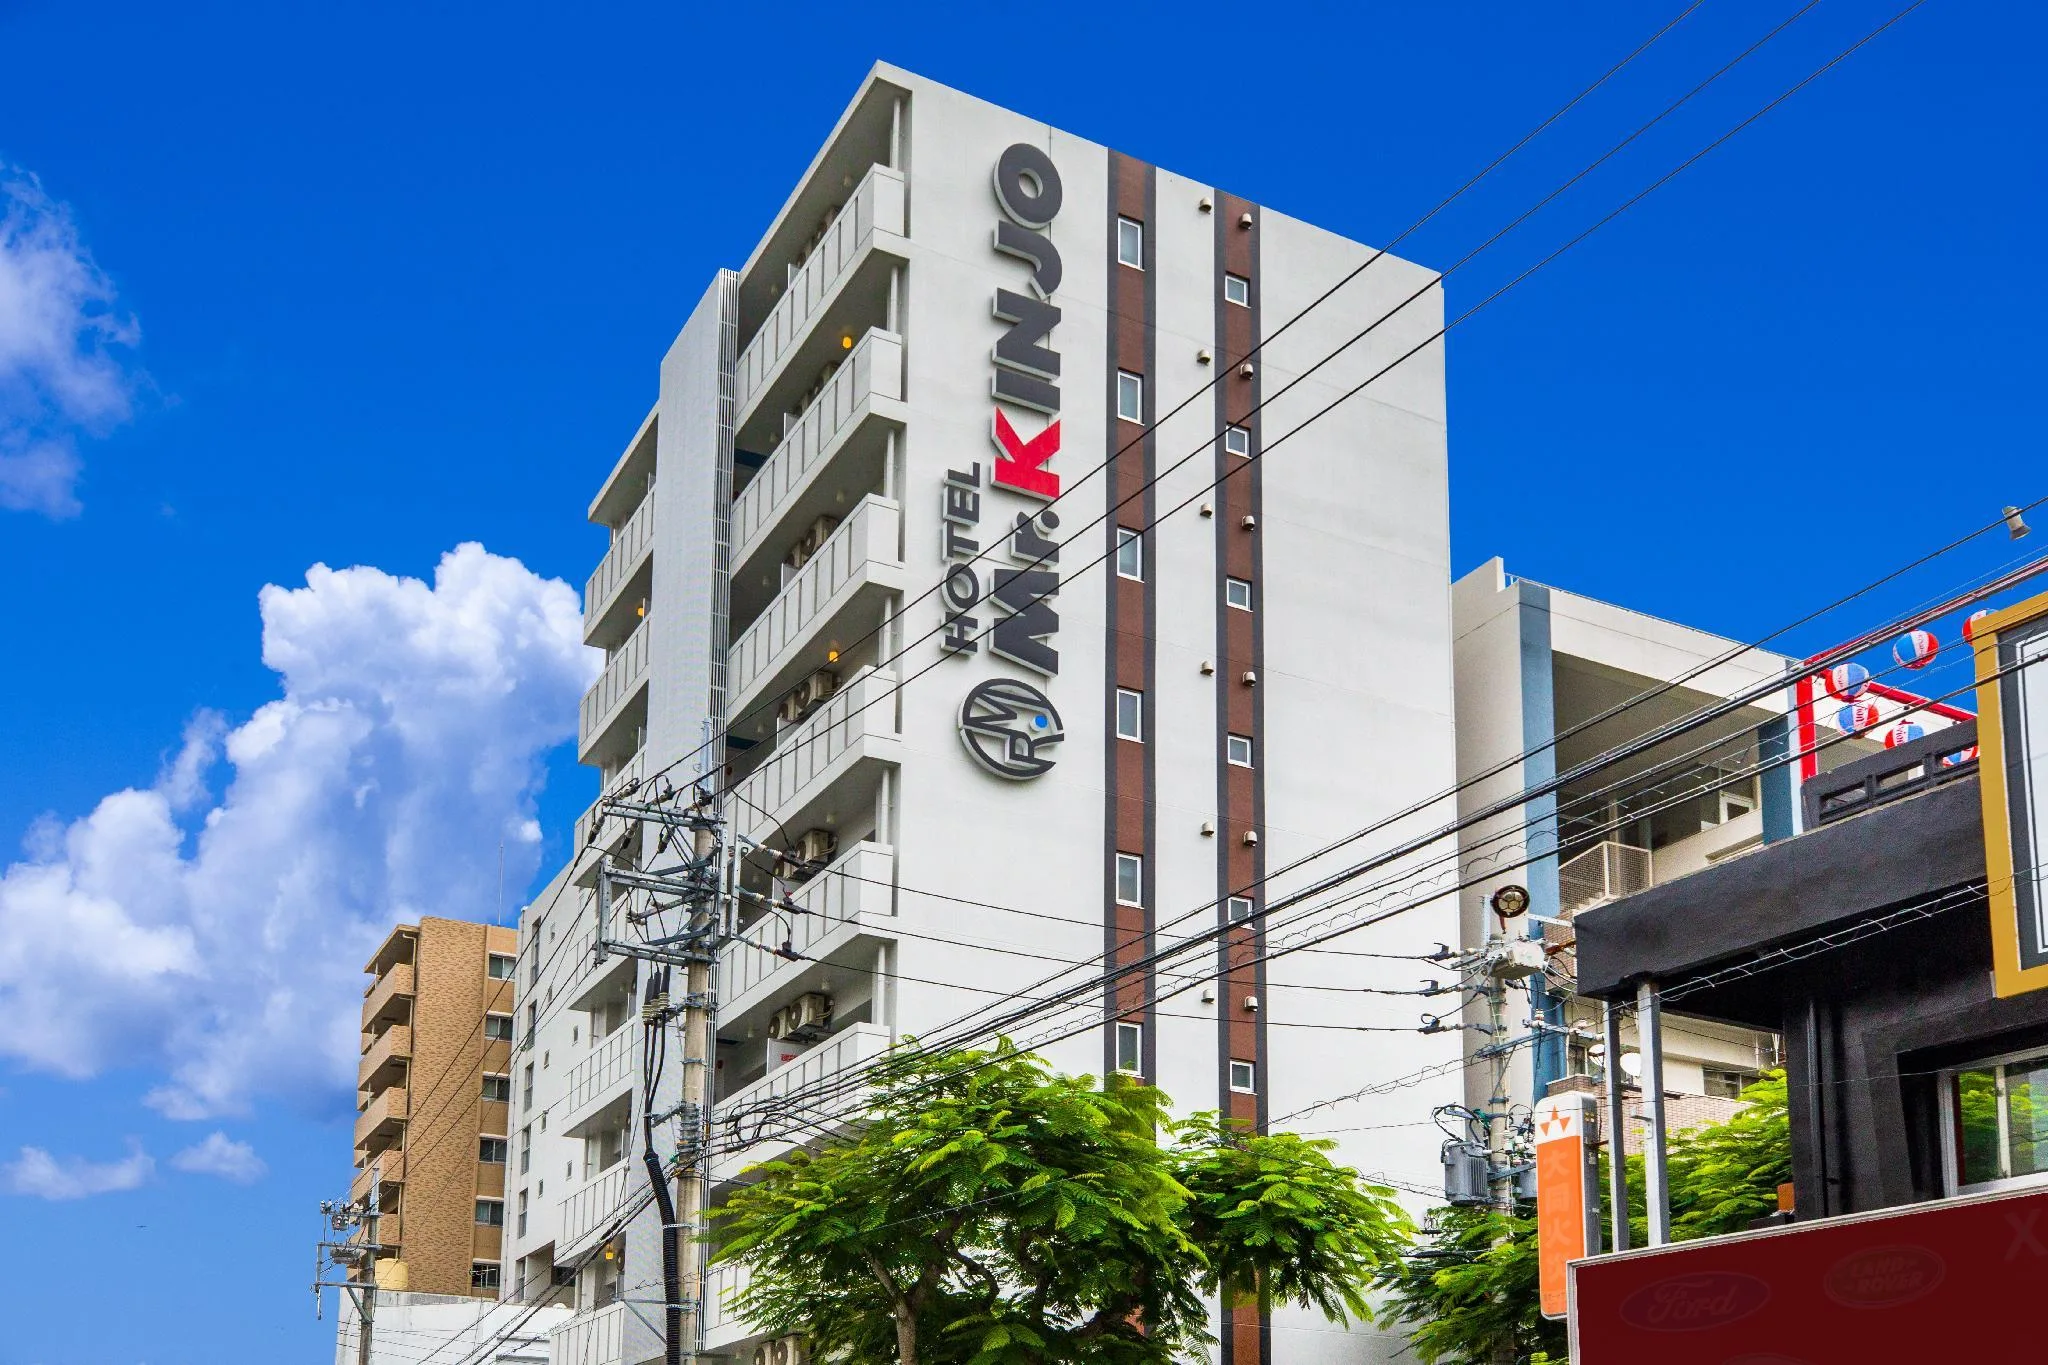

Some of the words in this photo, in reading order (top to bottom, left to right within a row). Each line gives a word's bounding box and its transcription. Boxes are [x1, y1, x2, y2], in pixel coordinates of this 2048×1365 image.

[942, 461, 981, 656] HOTEL
[1851, 1256, 1906, 1280] LAND
[1857, 1271, 1924, 1295] ROVER
[1647, 1279, 1739, 1323] Ford
